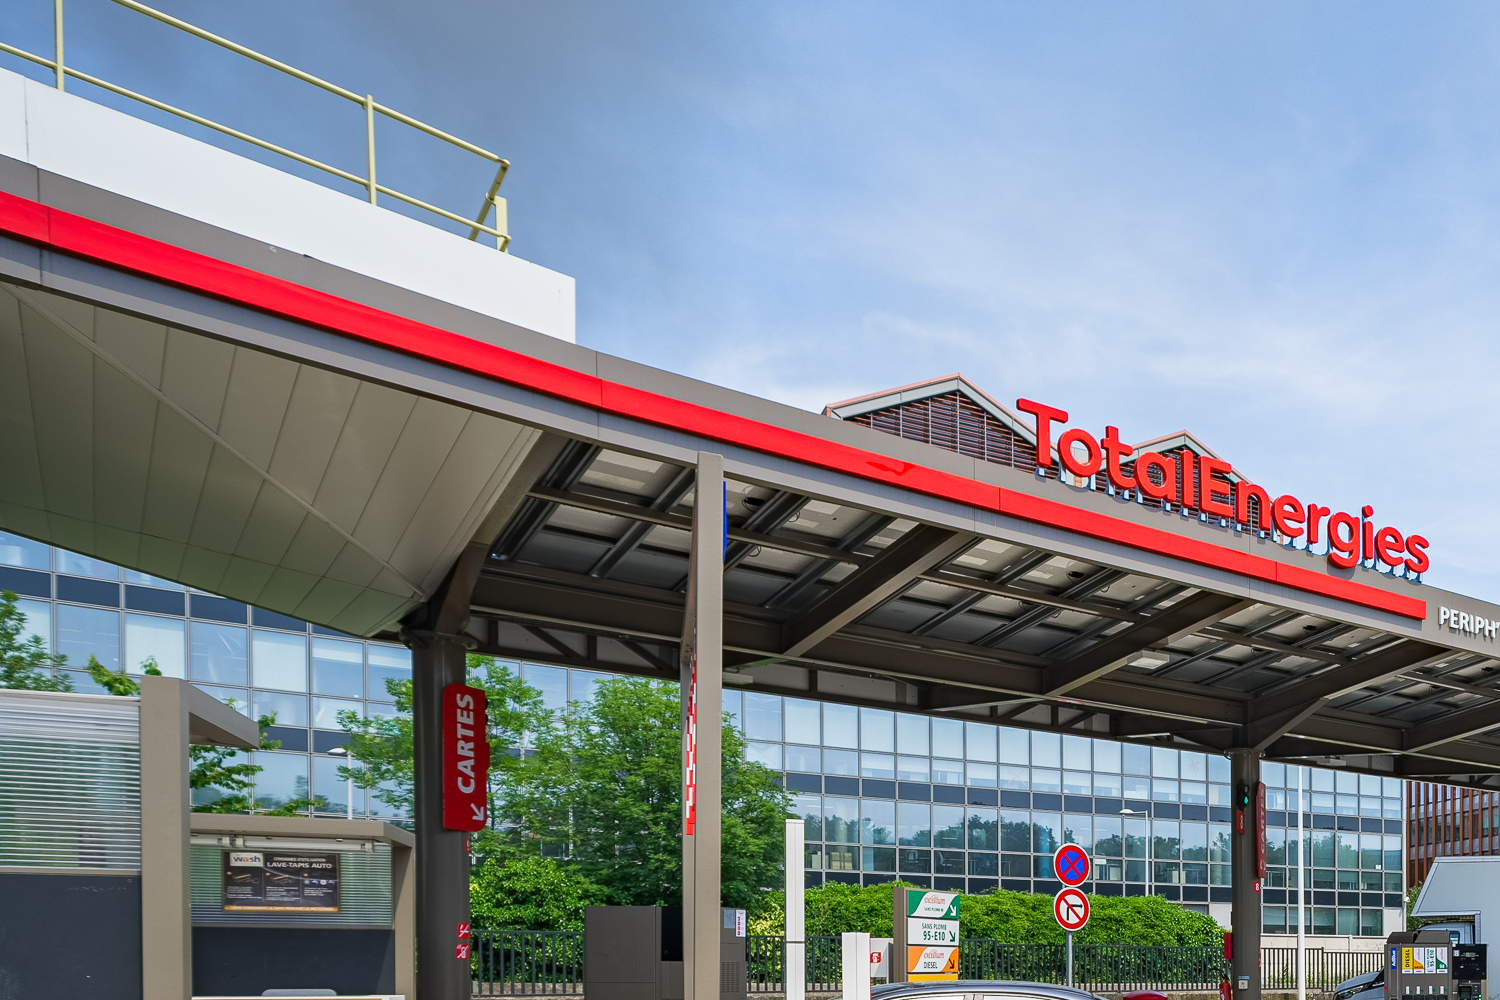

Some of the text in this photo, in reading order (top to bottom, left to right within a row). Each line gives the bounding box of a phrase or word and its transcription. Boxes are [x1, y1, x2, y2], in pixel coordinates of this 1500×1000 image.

[1016, 398, 1430, 573] TotalEnergies
[1439, 606, 1500, 638] PERIPH'
[456, 693, 475, 794] CARTES
[1256, 883, 1260, 891] 8
